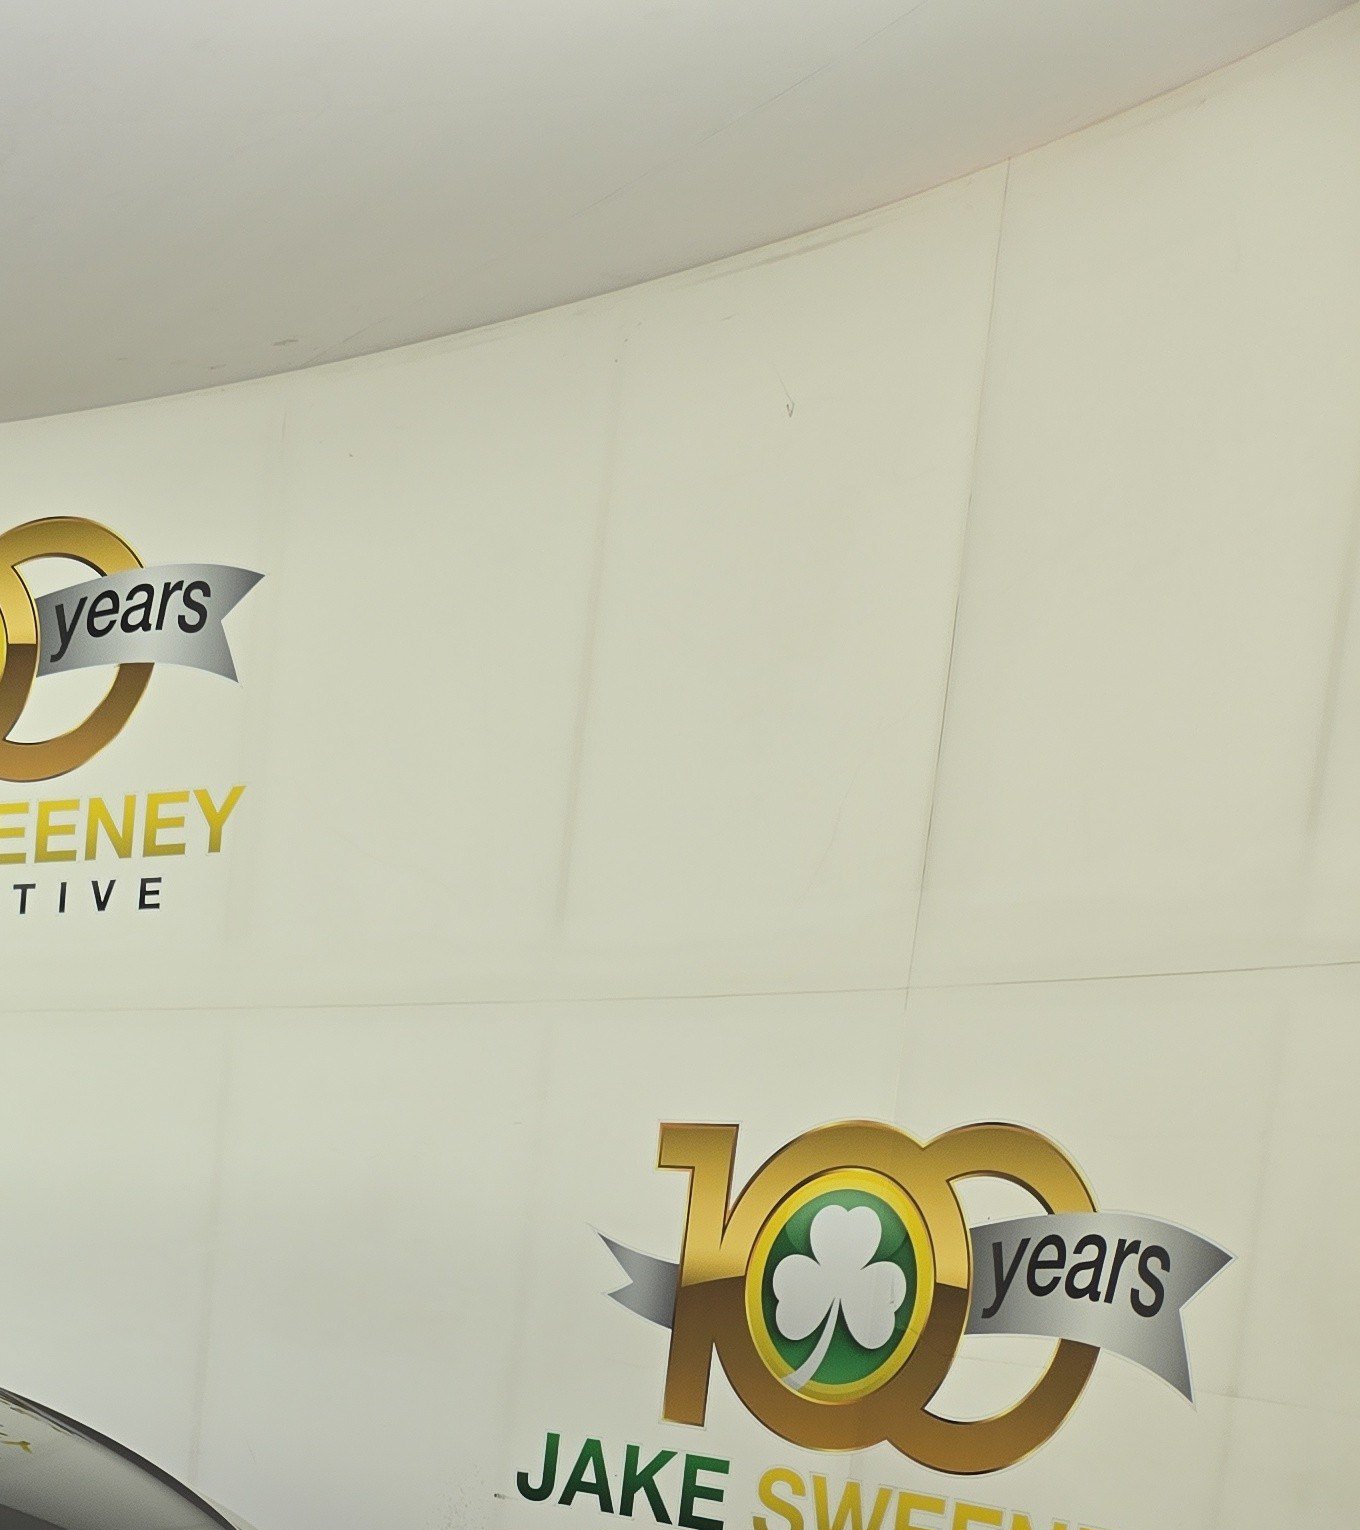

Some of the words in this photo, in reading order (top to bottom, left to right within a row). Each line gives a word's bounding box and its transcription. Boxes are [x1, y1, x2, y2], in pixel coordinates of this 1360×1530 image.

[49, 575, 213, 663] years
[657, 1120, 1100, 1475] 100
[981, 1230, 1172, 1319] years
